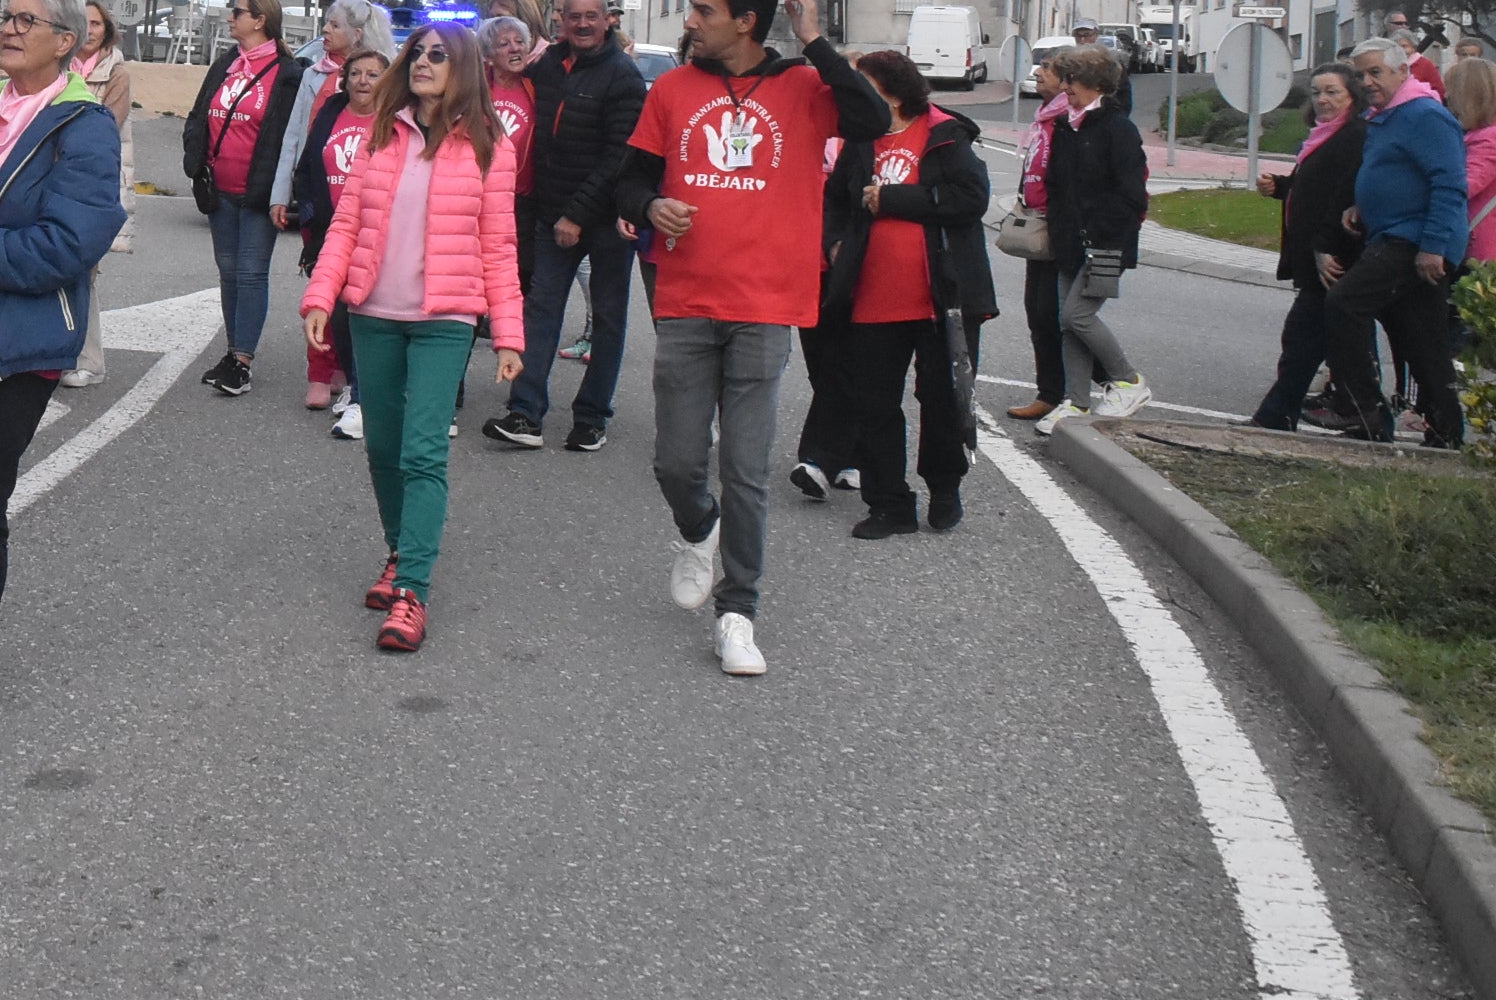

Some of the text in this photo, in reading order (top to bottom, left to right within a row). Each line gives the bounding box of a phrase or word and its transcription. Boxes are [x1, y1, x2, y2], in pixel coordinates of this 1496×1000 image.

[680, 128, 692, 162] JUNTOS
[768, 121, 779, 133] EL
[696, 172, 754, 190] BÉJAR
